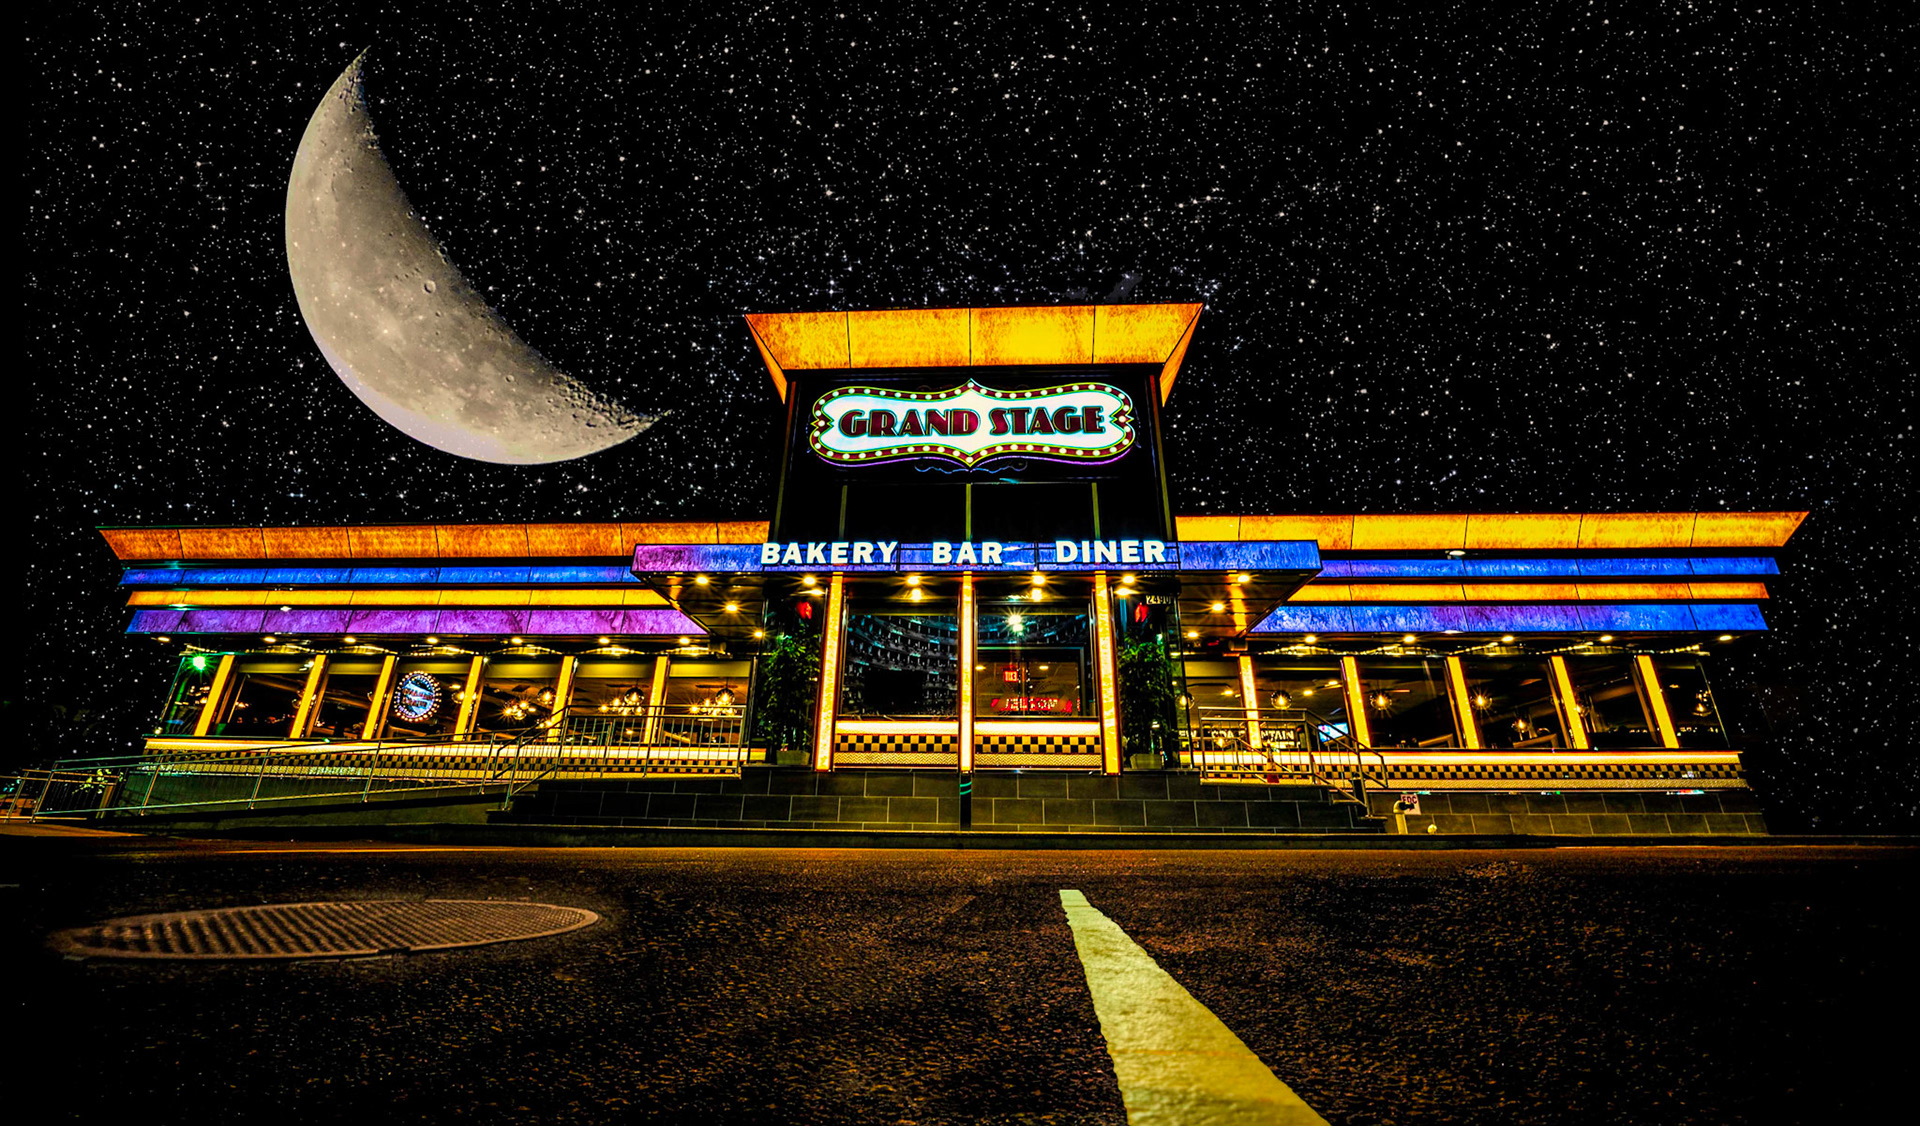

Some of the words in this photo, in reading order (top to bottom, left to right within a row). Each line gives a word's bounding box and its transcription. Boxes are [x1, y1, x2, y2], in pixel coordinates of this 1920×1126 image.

[839, 408, 979, 437] GRAND
[988, 406, 1106, 436] STAGE
[761, 541, 899, 565] BAKERY
[932, 541, 1003, 564] BAR
[1056, 540, 1165, 563] DINER
[1238, 730, 1295, 741] FNTAIN
